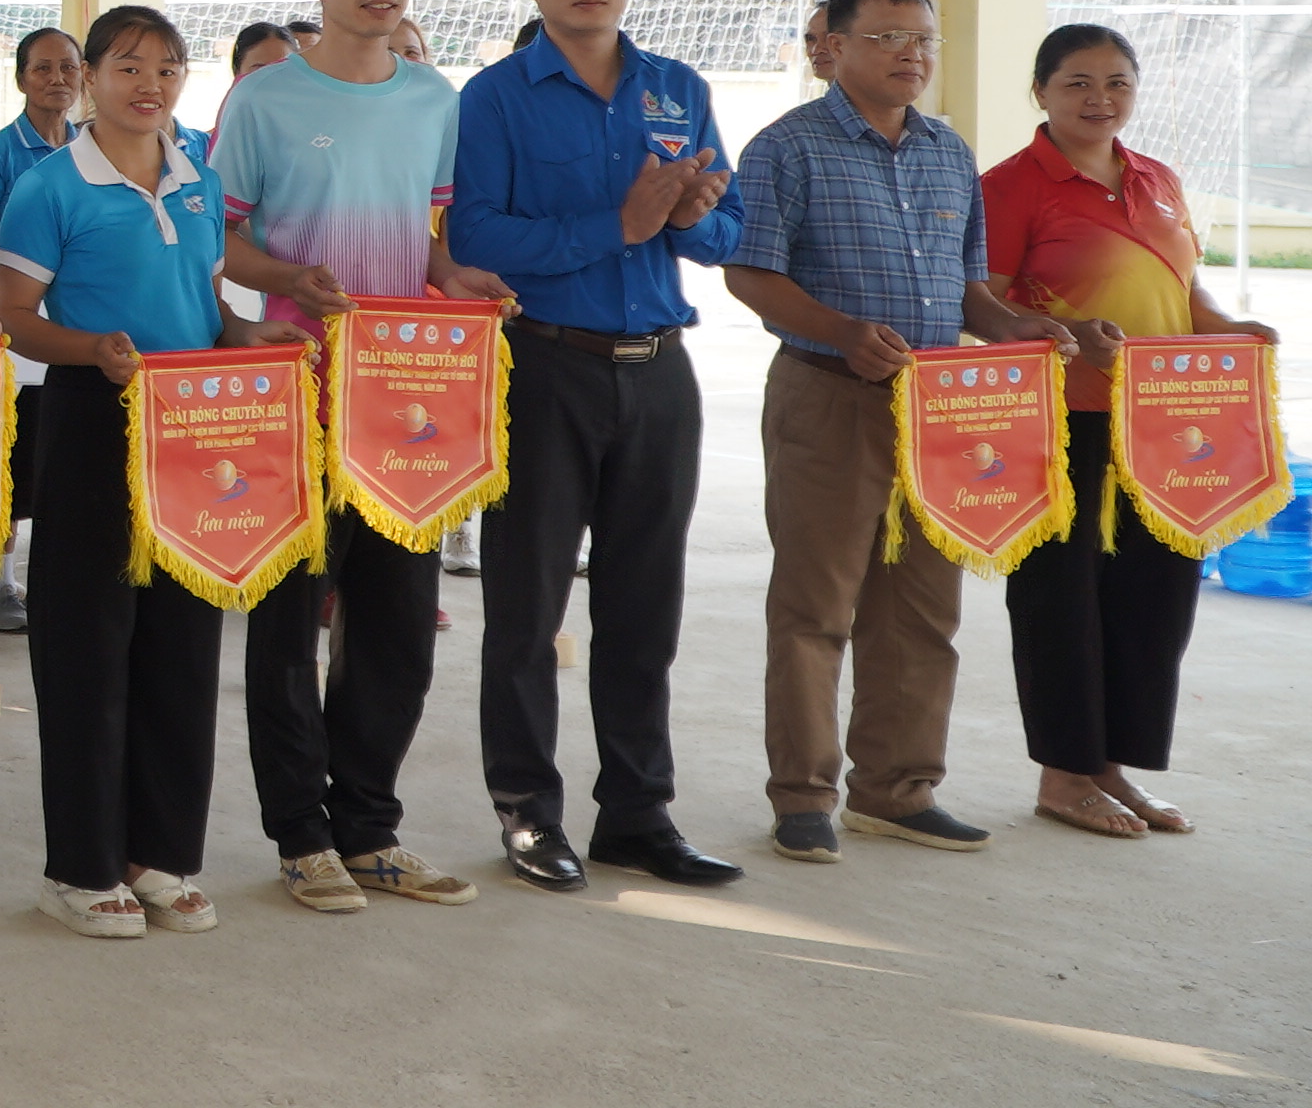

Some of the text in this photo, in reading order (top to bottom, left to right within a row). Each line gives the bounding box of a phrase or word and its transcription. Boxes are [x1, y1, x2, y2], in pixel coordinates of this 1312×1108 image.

[356, 345, 478, 369] GIẢI BÓNG CHUYỀN HƠI
[1138, 375, 1249, 394] GIẢI BÓNG CHUYỀN HƠI
[162, 399, 287, 425] GIẢI BÓNG CHUYỀN HƠI
[926, 388, 1038, 411] GIẢI BÓNG CHUYỀN HƠI
[373, 450, 451, 476] Lưu niệm
[1158, 469, 1228, 493] Lưu niệm
[949, 486, 1019, 513] Lưu niệm
[188, 508, 266, 538] Lưu niệm
